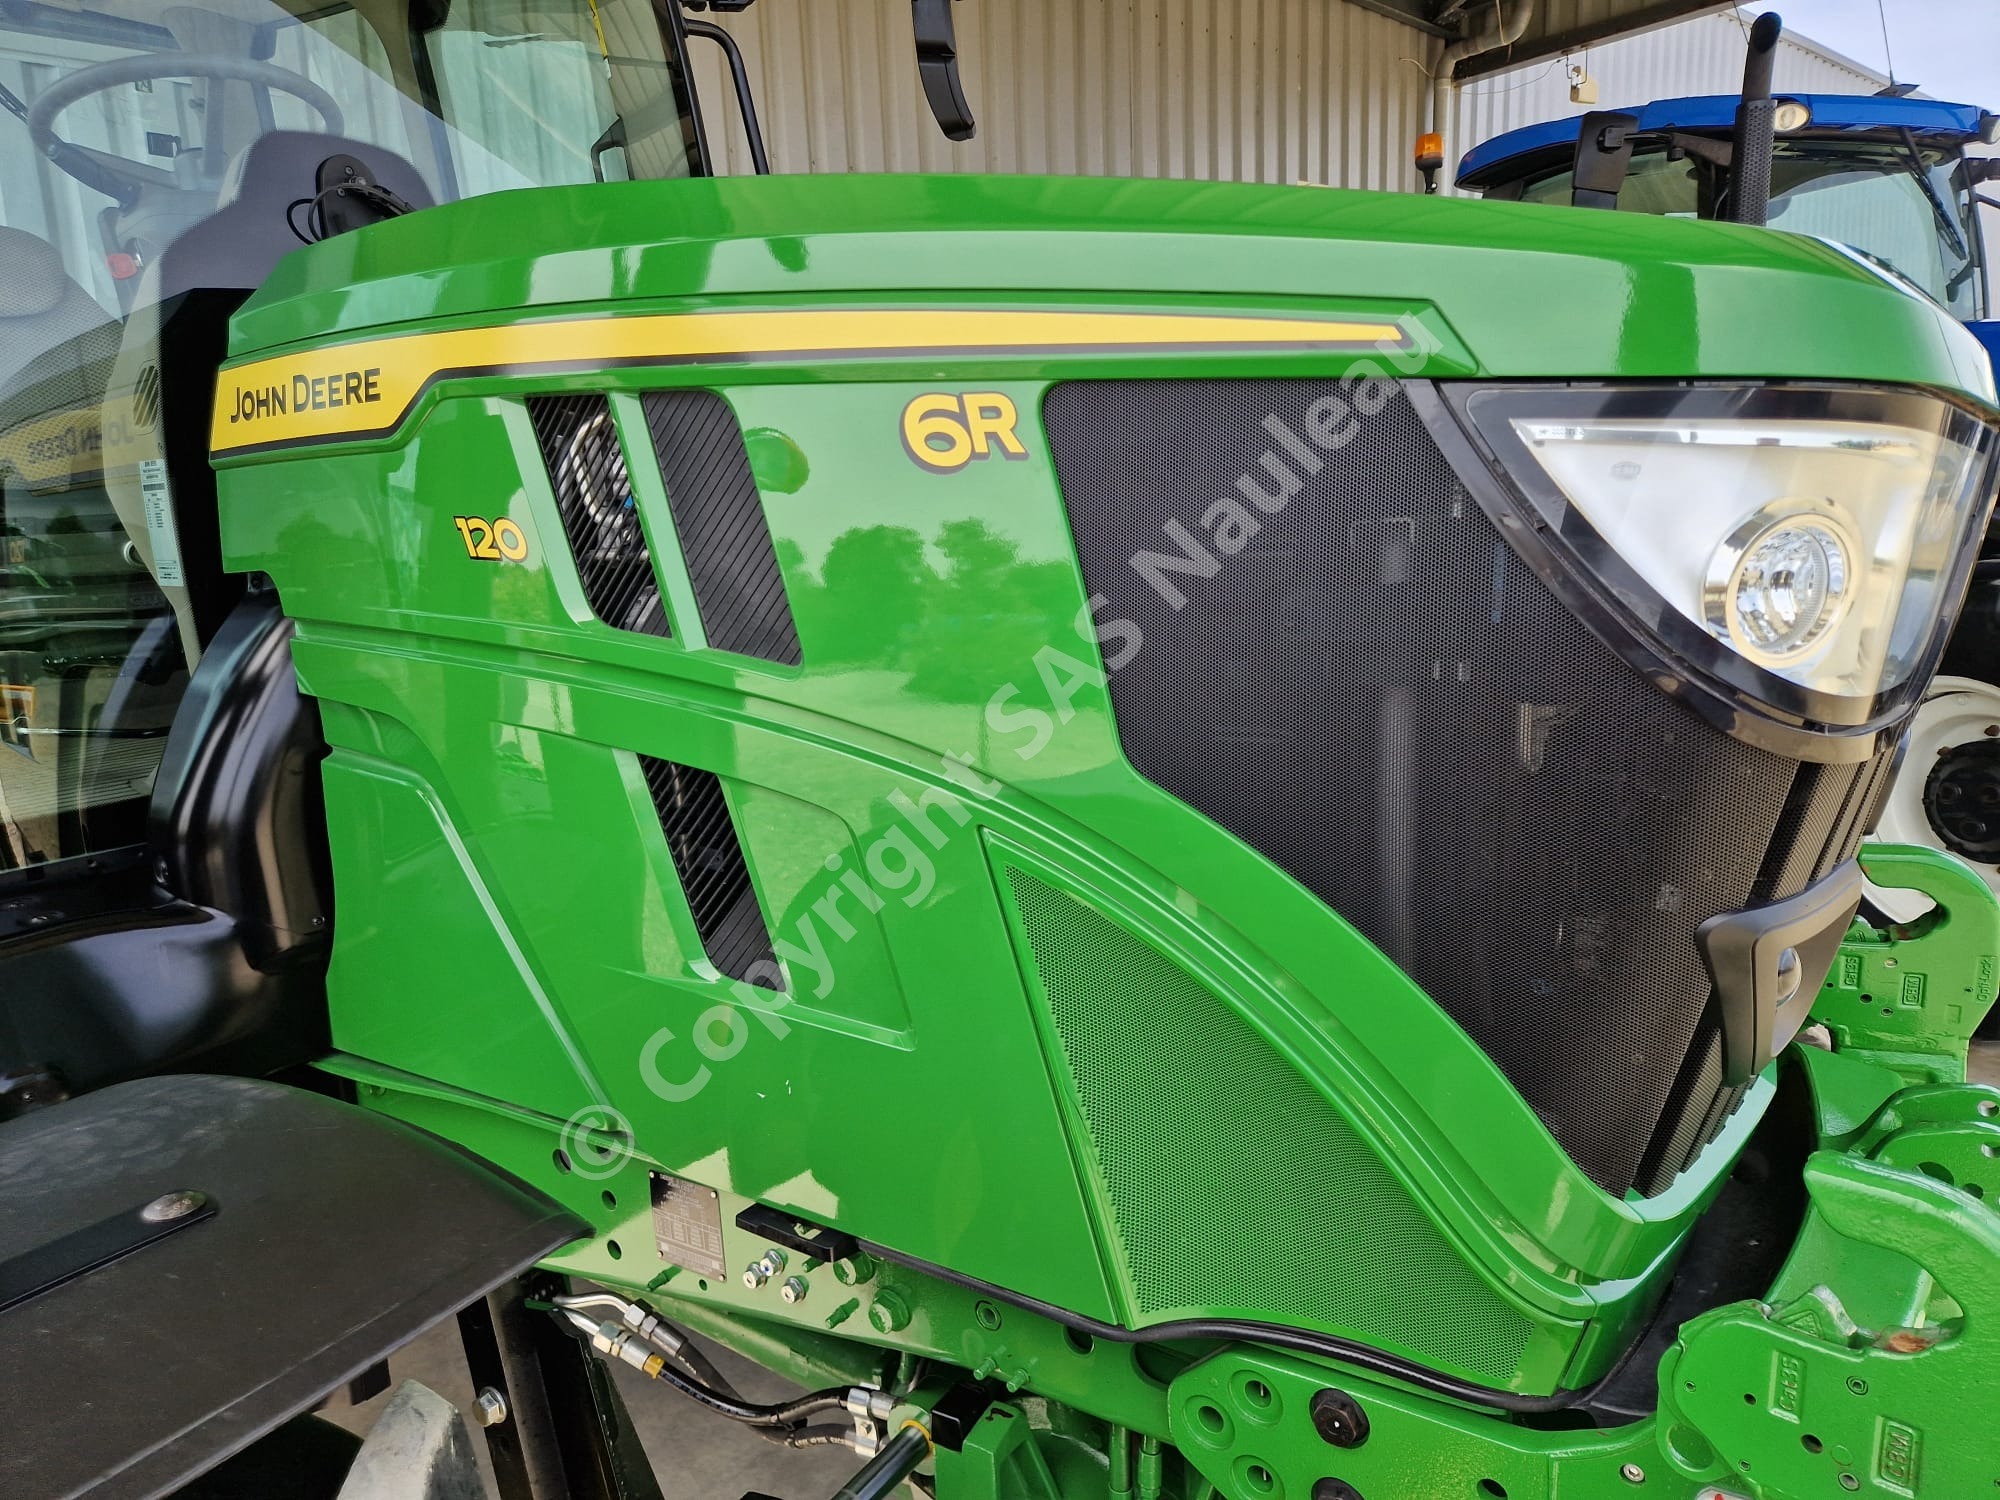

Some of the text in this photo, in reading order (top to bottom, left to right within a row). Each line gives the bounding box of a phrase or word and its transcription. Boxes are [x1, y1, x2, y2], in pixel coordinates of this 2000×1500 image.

[230, 368, 381, 424] JOHN DEERE
[901, 390, 1028, 475] 6R
[453, 515, 529, 563] 120
[1886, 1432, 1911, 1478] CBM
